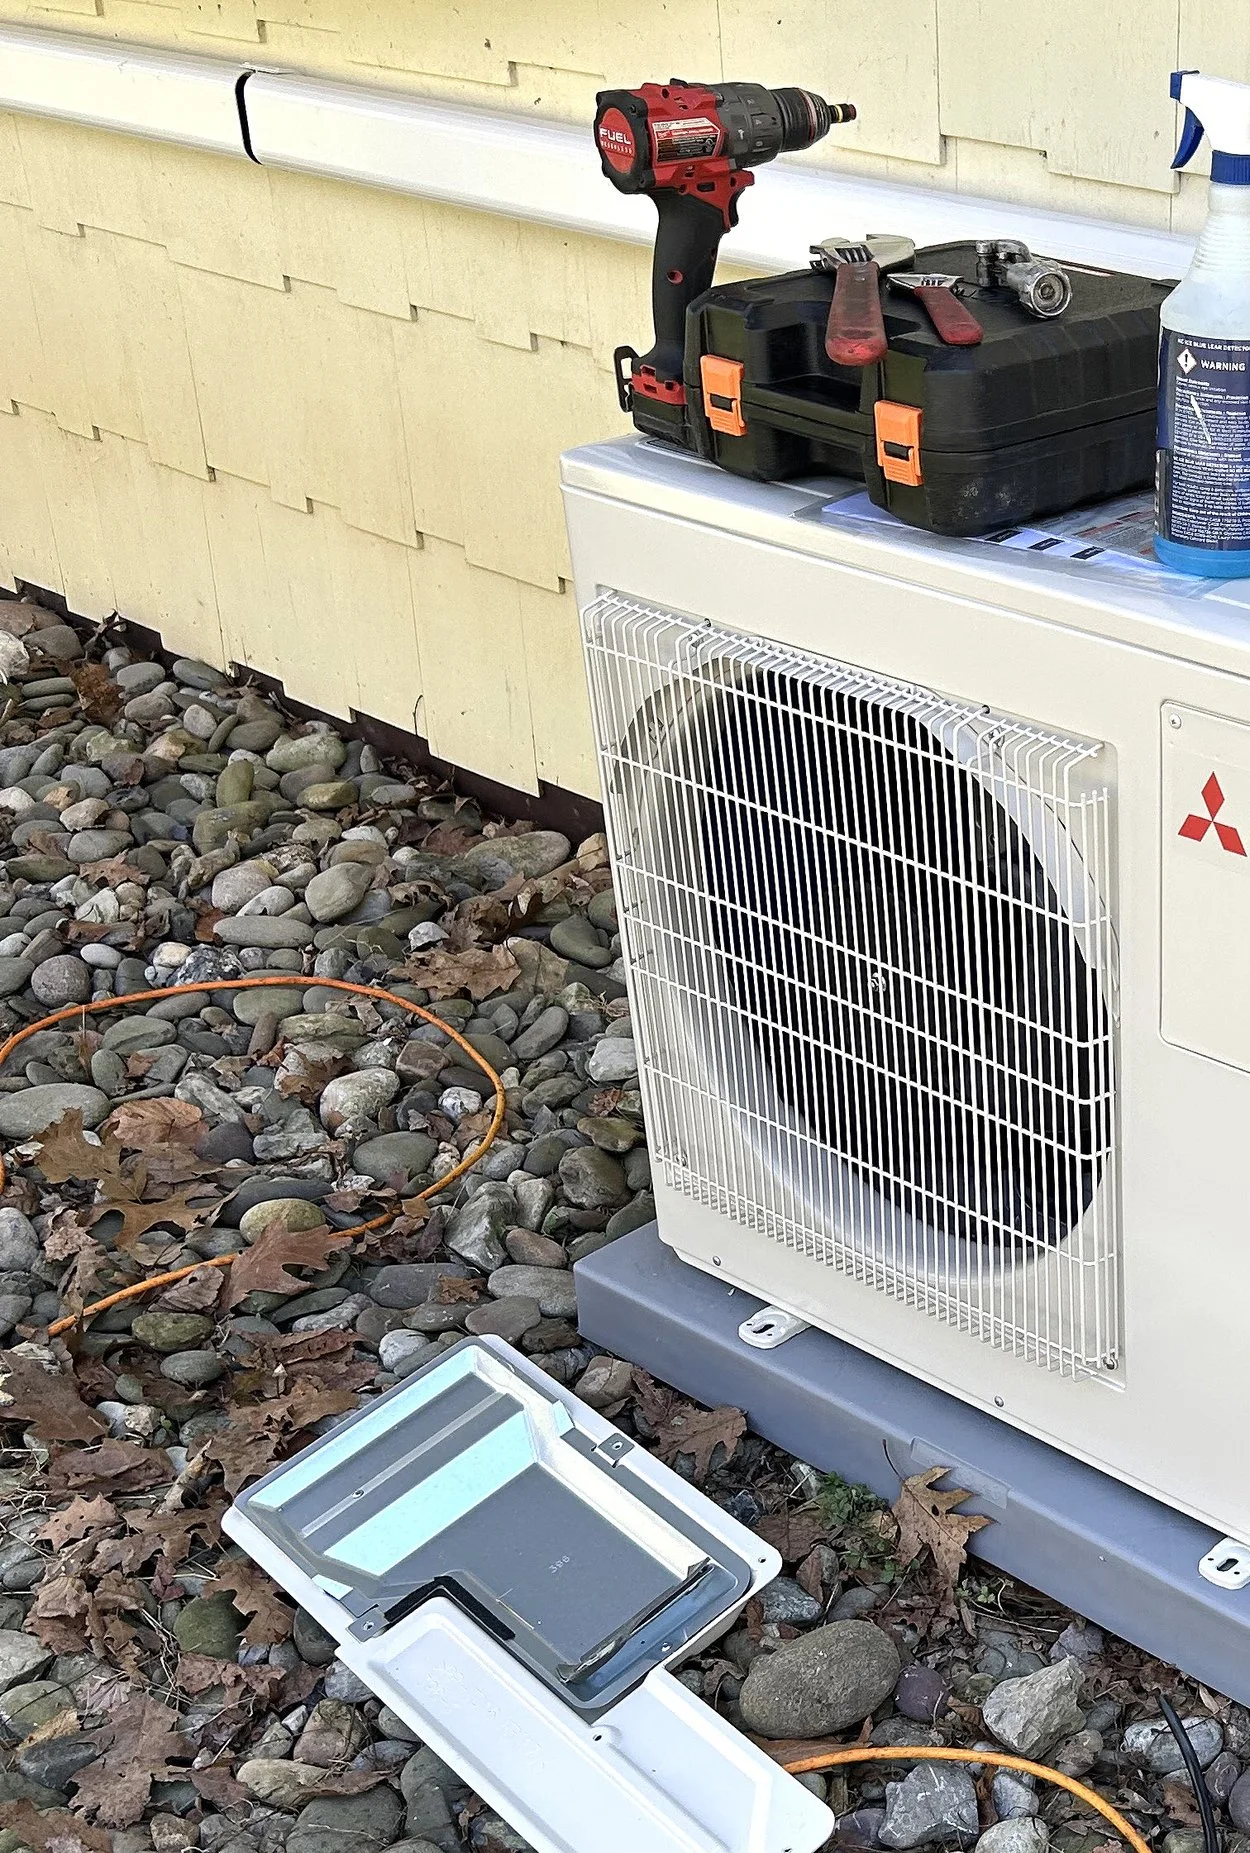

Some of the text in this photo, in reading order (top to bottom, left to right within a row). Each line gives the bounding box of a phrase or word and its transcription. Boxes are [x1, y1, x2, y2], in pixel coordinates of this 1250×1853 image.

[599, 128, 632, 145] FUEL
[1193, 341, 1206, 349] BLUE
[1207, 343, 1222, 351] LEAK
[1200, 359, 1246, 372] WARNING
